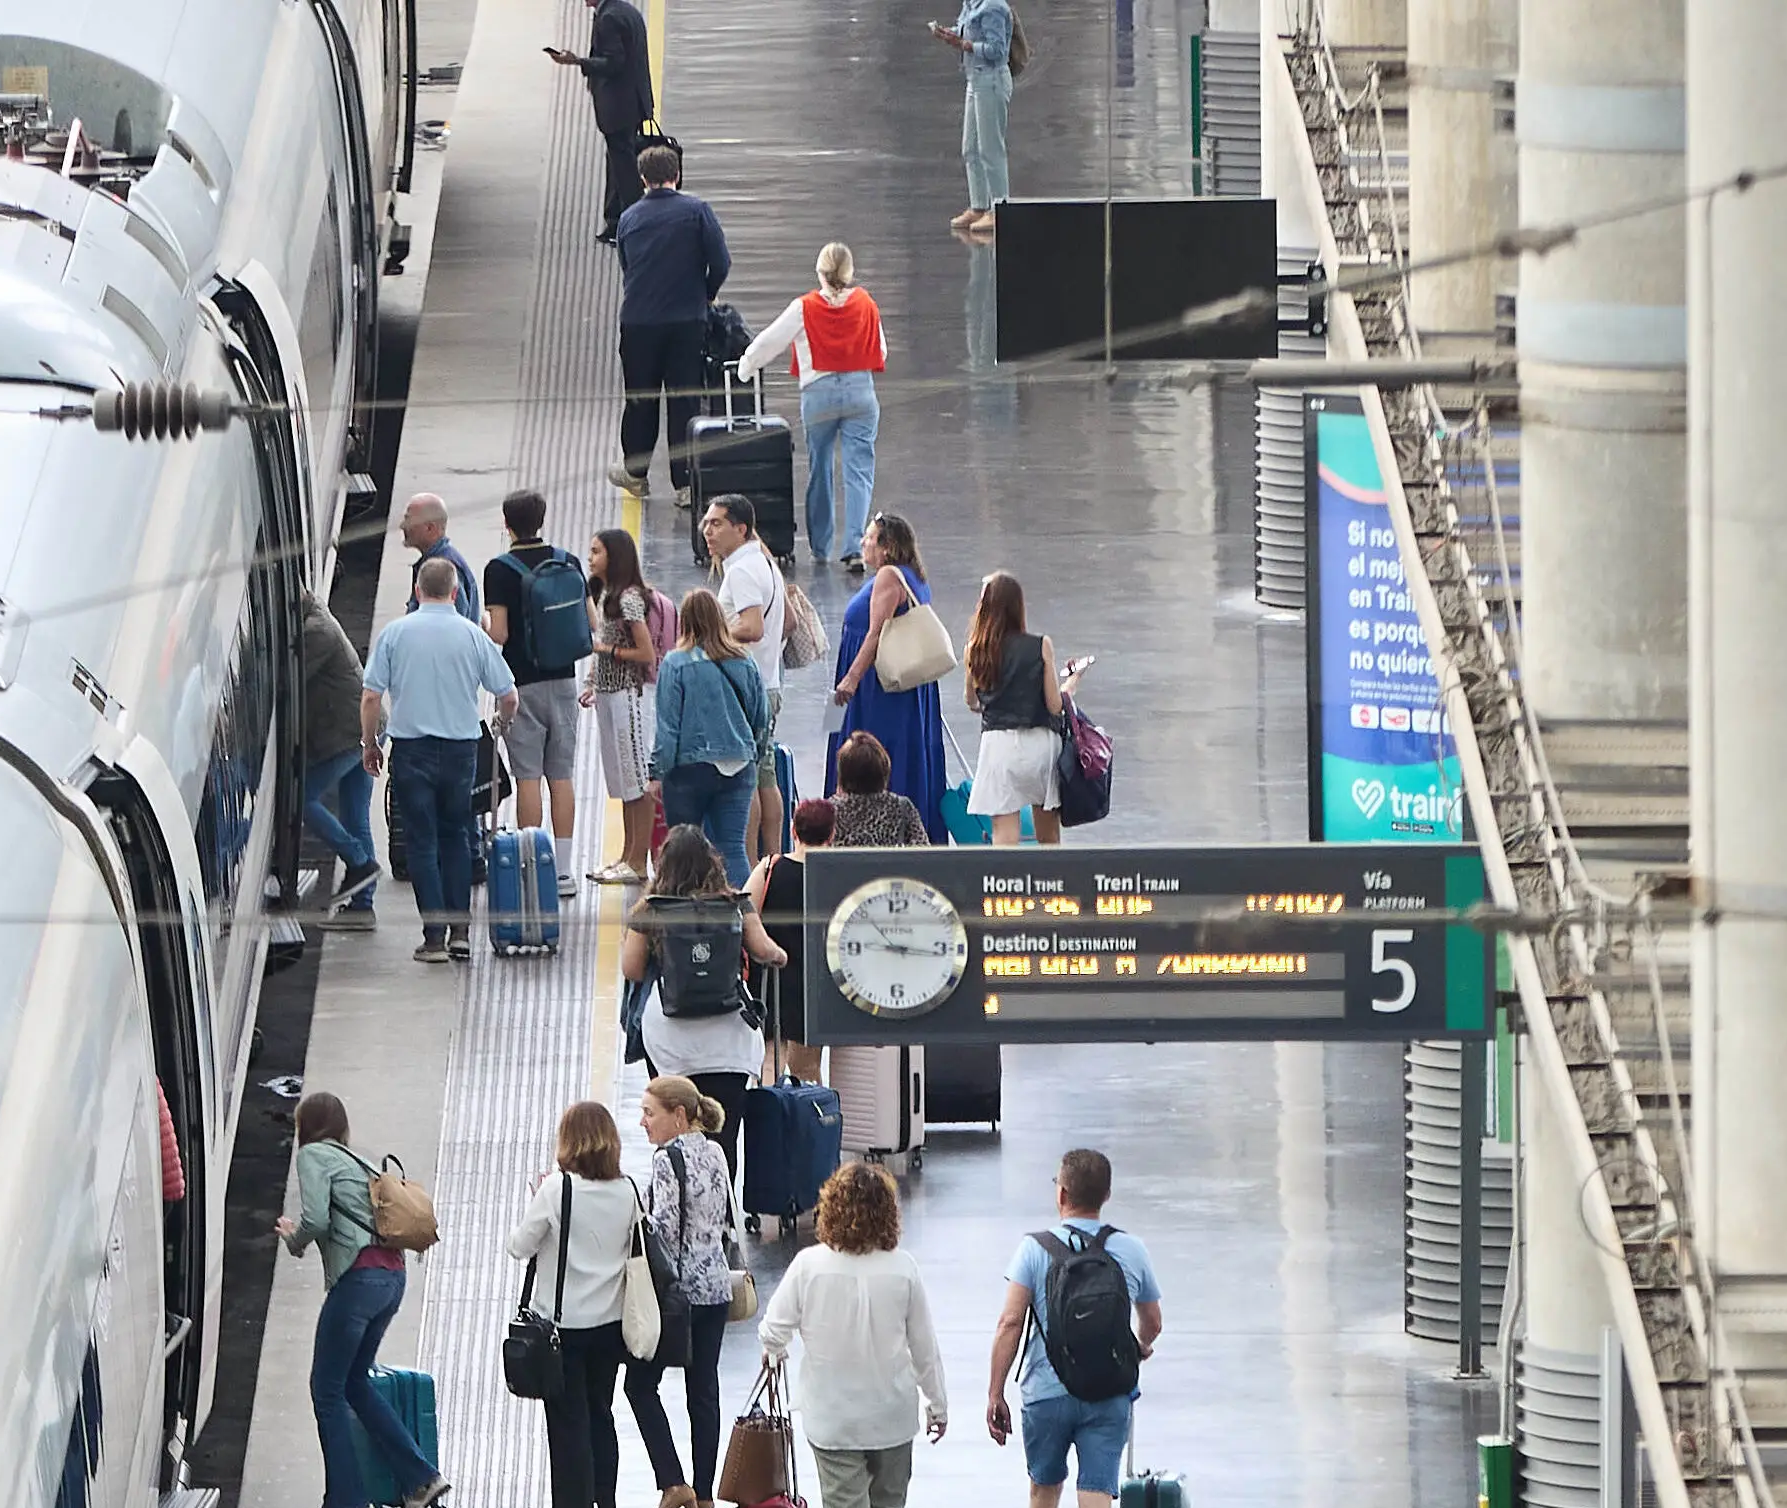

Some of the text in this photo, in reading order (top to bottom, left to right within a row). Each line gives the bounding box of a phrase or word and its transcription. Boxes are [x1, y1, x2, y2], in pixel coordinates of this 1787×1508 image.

[1347, 519, 1395, 548] Si no
[1348, 552, 1405, 586] el mej
[1348, 587, 1372, 609] en
[1349, 619, 1428, 648] es porqu
[1350, 648, 1437, 678] no quiere
[983, 875, 1064, 893] Hora TIME
[1094, 874, 1180, 892] Tren TRAIN
[1362, 870, 1392, 890] Vía
[1363, 896, 1428, 910] PLATFORM
[983, 933, 1137, 953] Destino DESTINATION
[1372, 929, 1417, 1013] 5
[890, 983, 905, 999] 6
